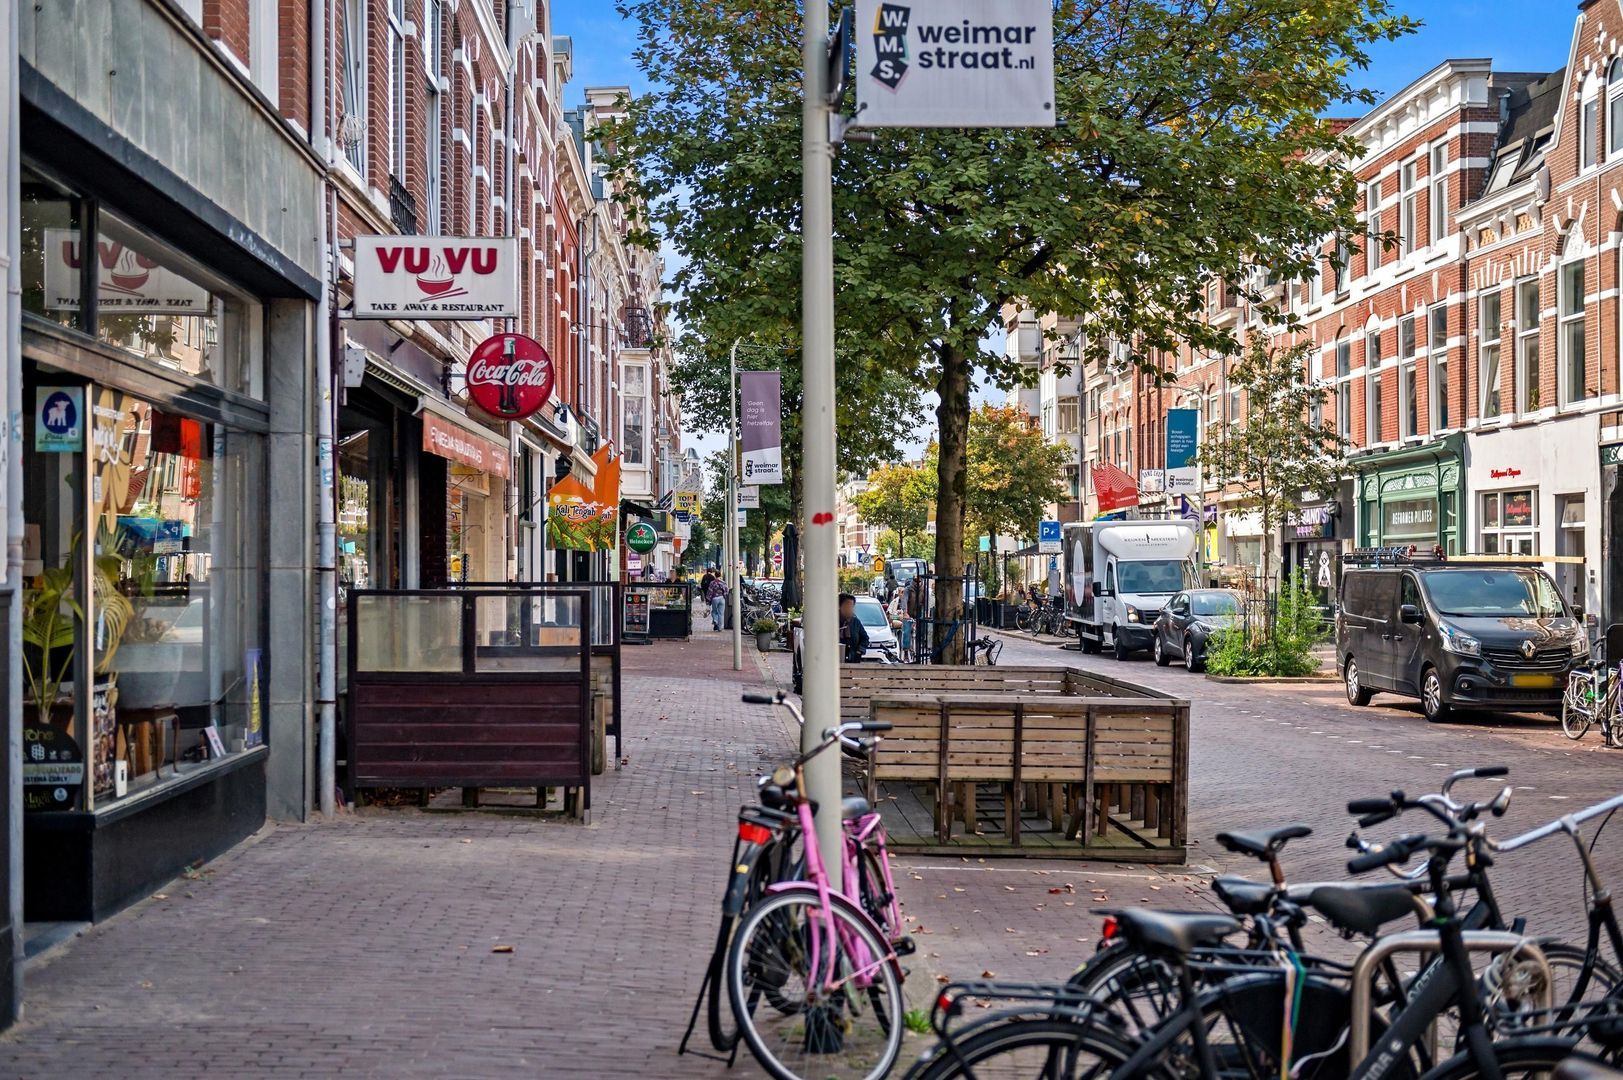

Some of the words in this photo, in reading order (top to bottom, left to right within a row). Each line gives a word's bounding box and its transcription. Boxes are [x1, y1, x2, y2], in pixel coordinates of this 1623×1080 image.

[917, 19, 1036, 45] weimar
[917, 47, 1035, 70] straat.nl
[370, 303, 397, 311] TAKE
[403, 303, 430, 311] AWAY
[441, 304, 505, 312] RESTAURANT
[555, 504, 570, 517] Kali
[569, 505, 596, 520] Tengah
[1414, 509, 1433, 524] PILATES
